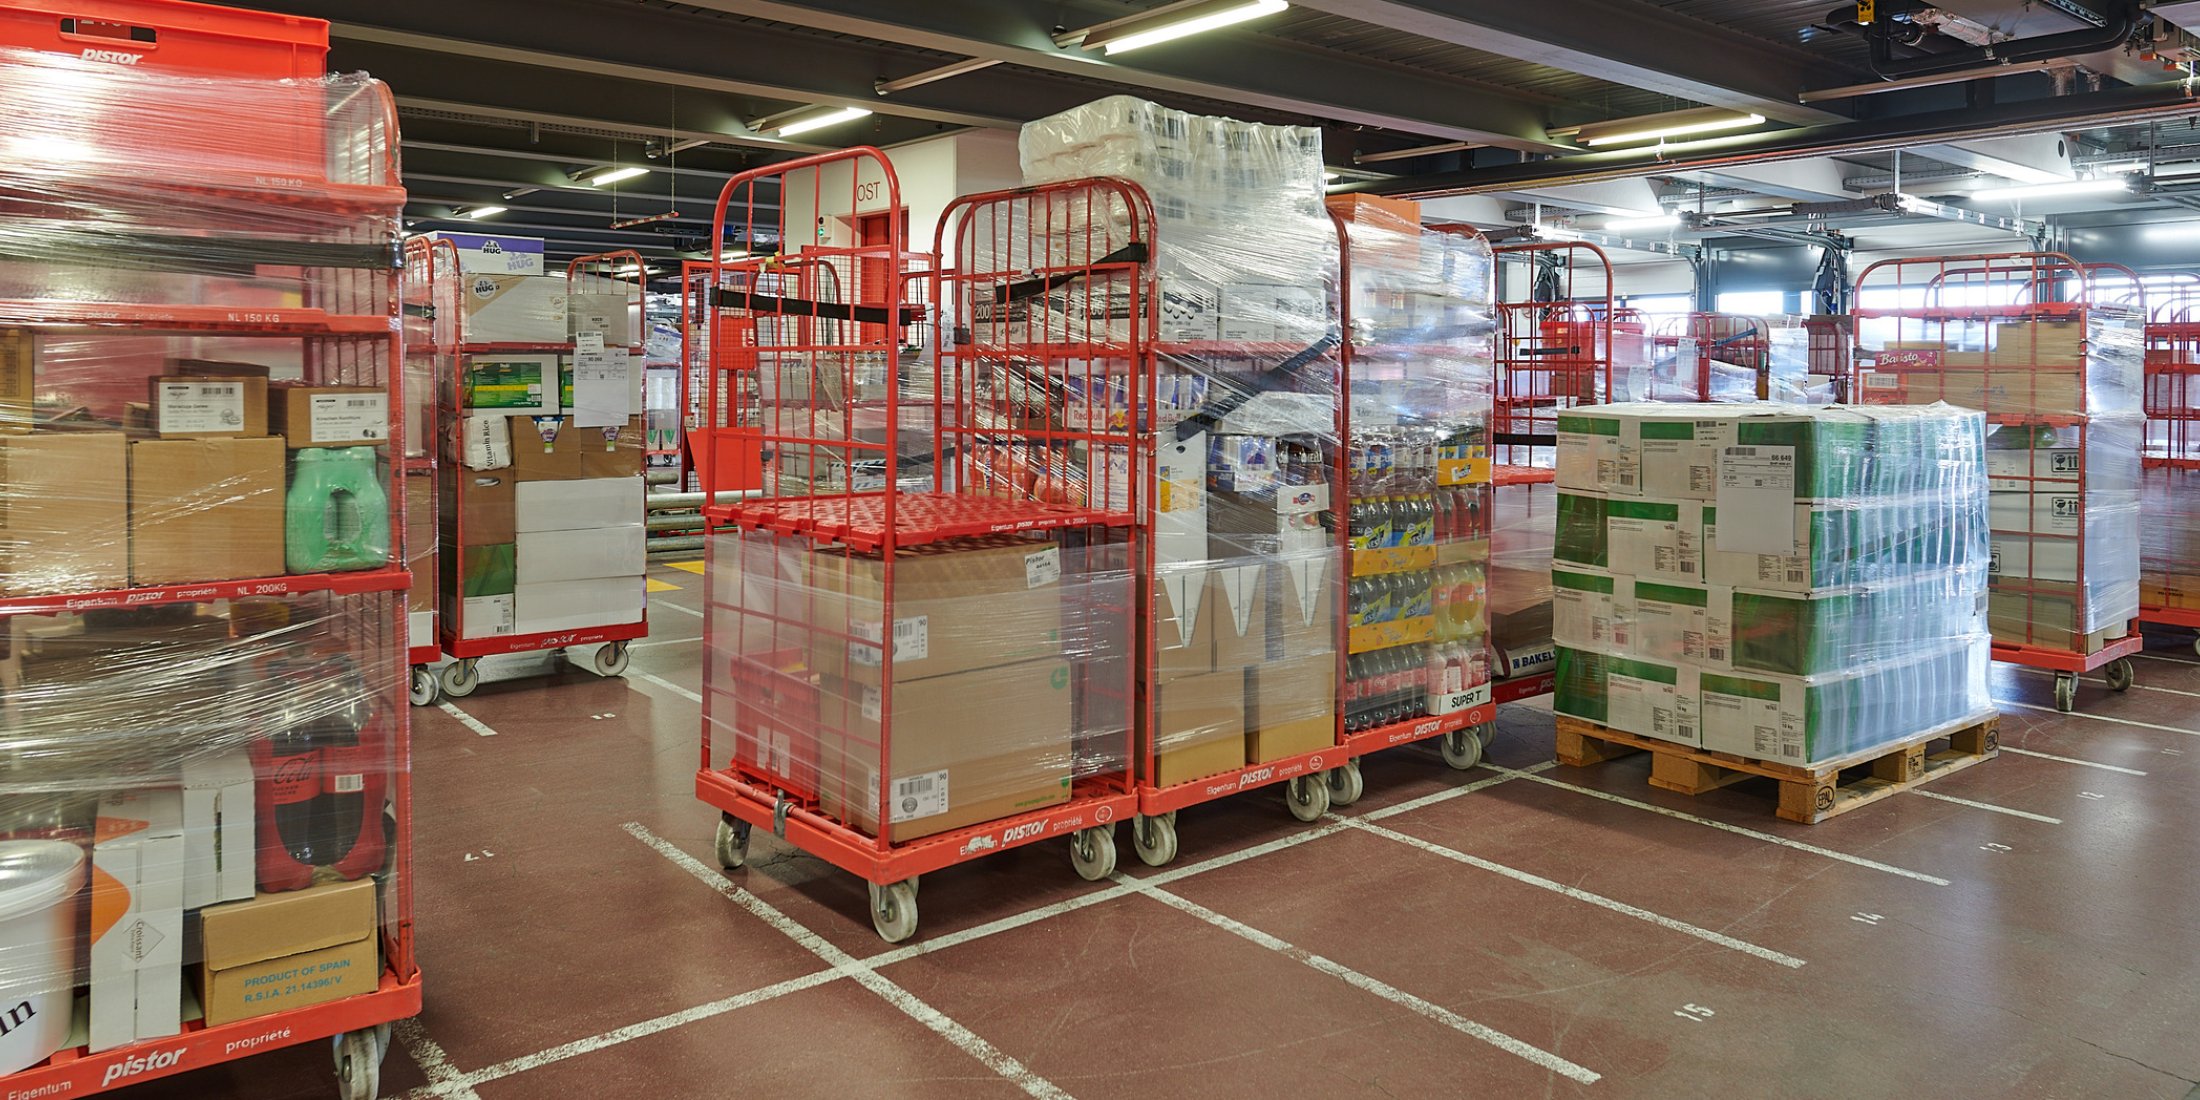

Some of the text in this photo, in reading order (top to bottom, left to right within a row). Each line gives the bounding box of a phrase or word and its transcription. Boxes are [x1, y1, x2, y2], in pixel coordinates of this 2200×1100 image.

[81, 48, 144, 65] pistor
[255, 175, 270, 185] NL
[272, 175, 288, 187] 150
[856, 181, 881, 201] OST
[483, 247, 501, 255] HUG
[507, 257, 534, 271] HUG
[475, 284, 494, 294] HUG
[227, 313, 241, 322] NL
[244, 314, 262, 322] 150
[265, 314, 280, 323] KG
[126, 590, 165, 604] pistor
[237, 586, 251, 596] NL
[255, 583, 288, 594] 200KG
[1451, 692, 1475, 708] SUPER
[1239, 766, 1276, 790] pistor
[1002, 819, 1049, 848] pistor
[1850, 911, 1886, 926] 14
[136, 921, 145, 960] Croissant
[244, 959, 351, 988] PRODUCT OF SPAIN
[1673, 1003, 1716, 1022] 15
[102, 1047, 188, 1088] pistor
